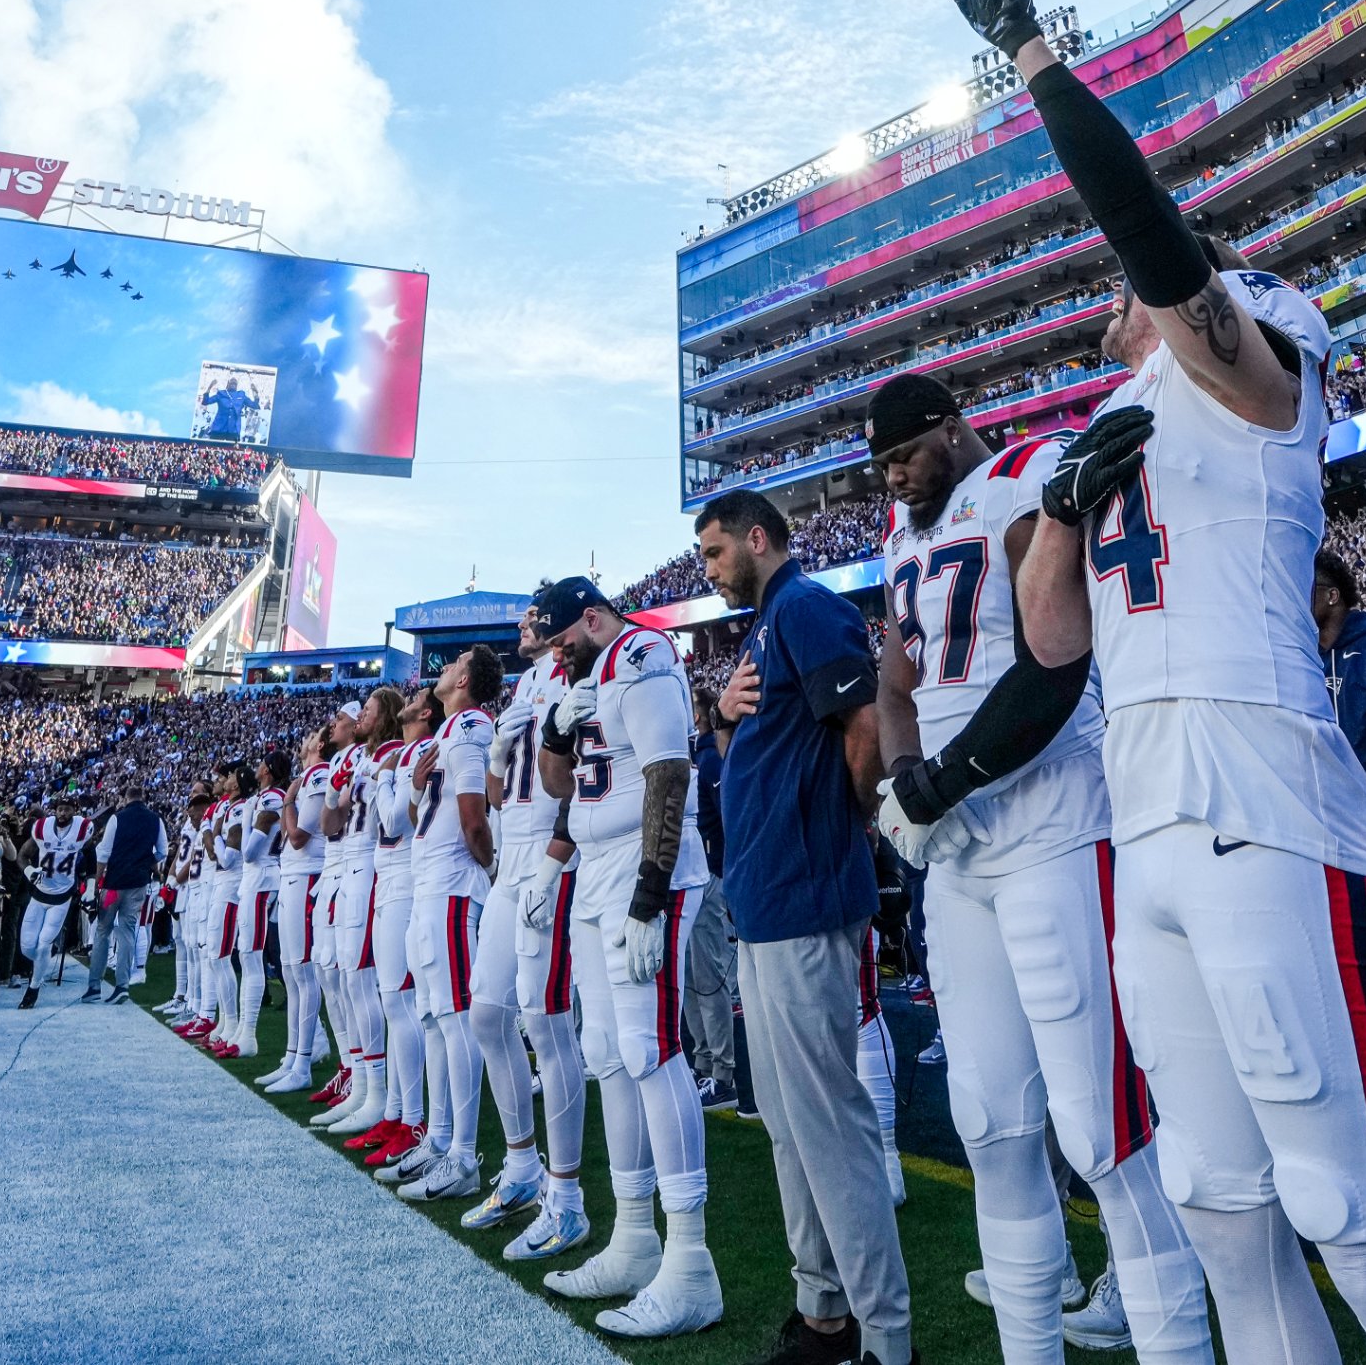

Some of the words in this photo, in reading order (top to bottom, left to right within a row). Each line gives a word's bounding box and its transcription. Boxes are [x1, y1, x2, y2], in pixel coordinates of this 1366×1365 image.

[72, 177, 252, 227] STADIUM
[894, 537, 989, 687] 97
[40, 852, 77, 879] 44
[878, 886, 902, 894] verizon
